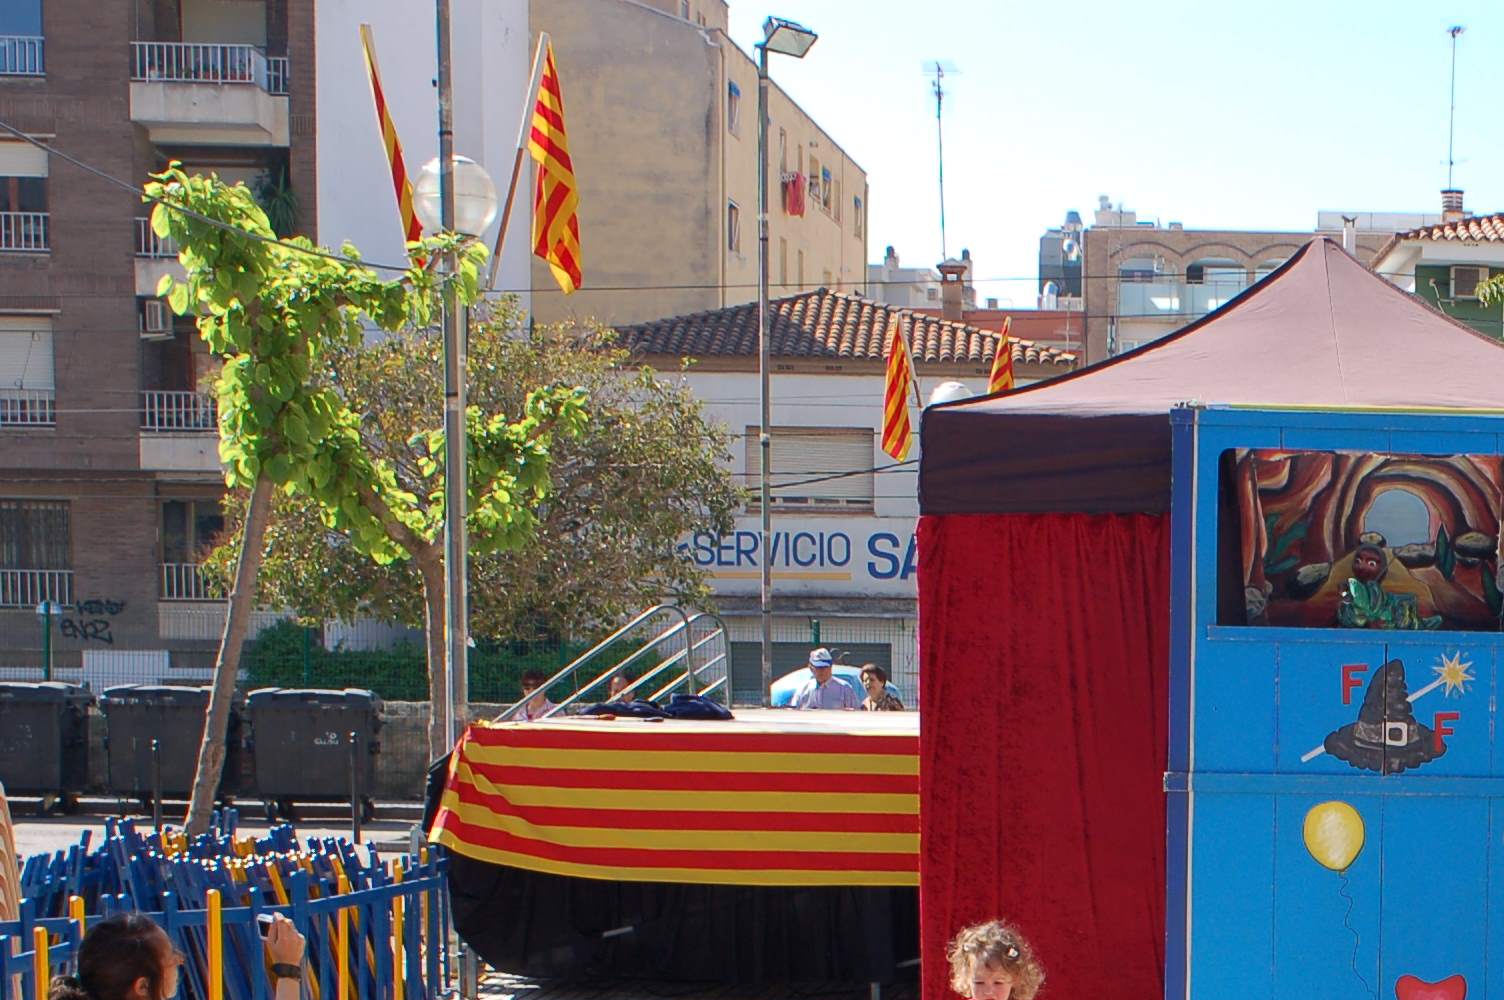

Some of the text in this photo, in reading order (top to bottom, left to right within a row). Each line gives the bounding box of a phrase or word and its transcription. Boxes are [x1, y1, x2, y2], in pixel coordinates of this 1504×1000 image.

[693, 531, 851, 567] SERVICIO
[1340, 663, 1368, 705] F
[1433, 711, 1460, 754] F
